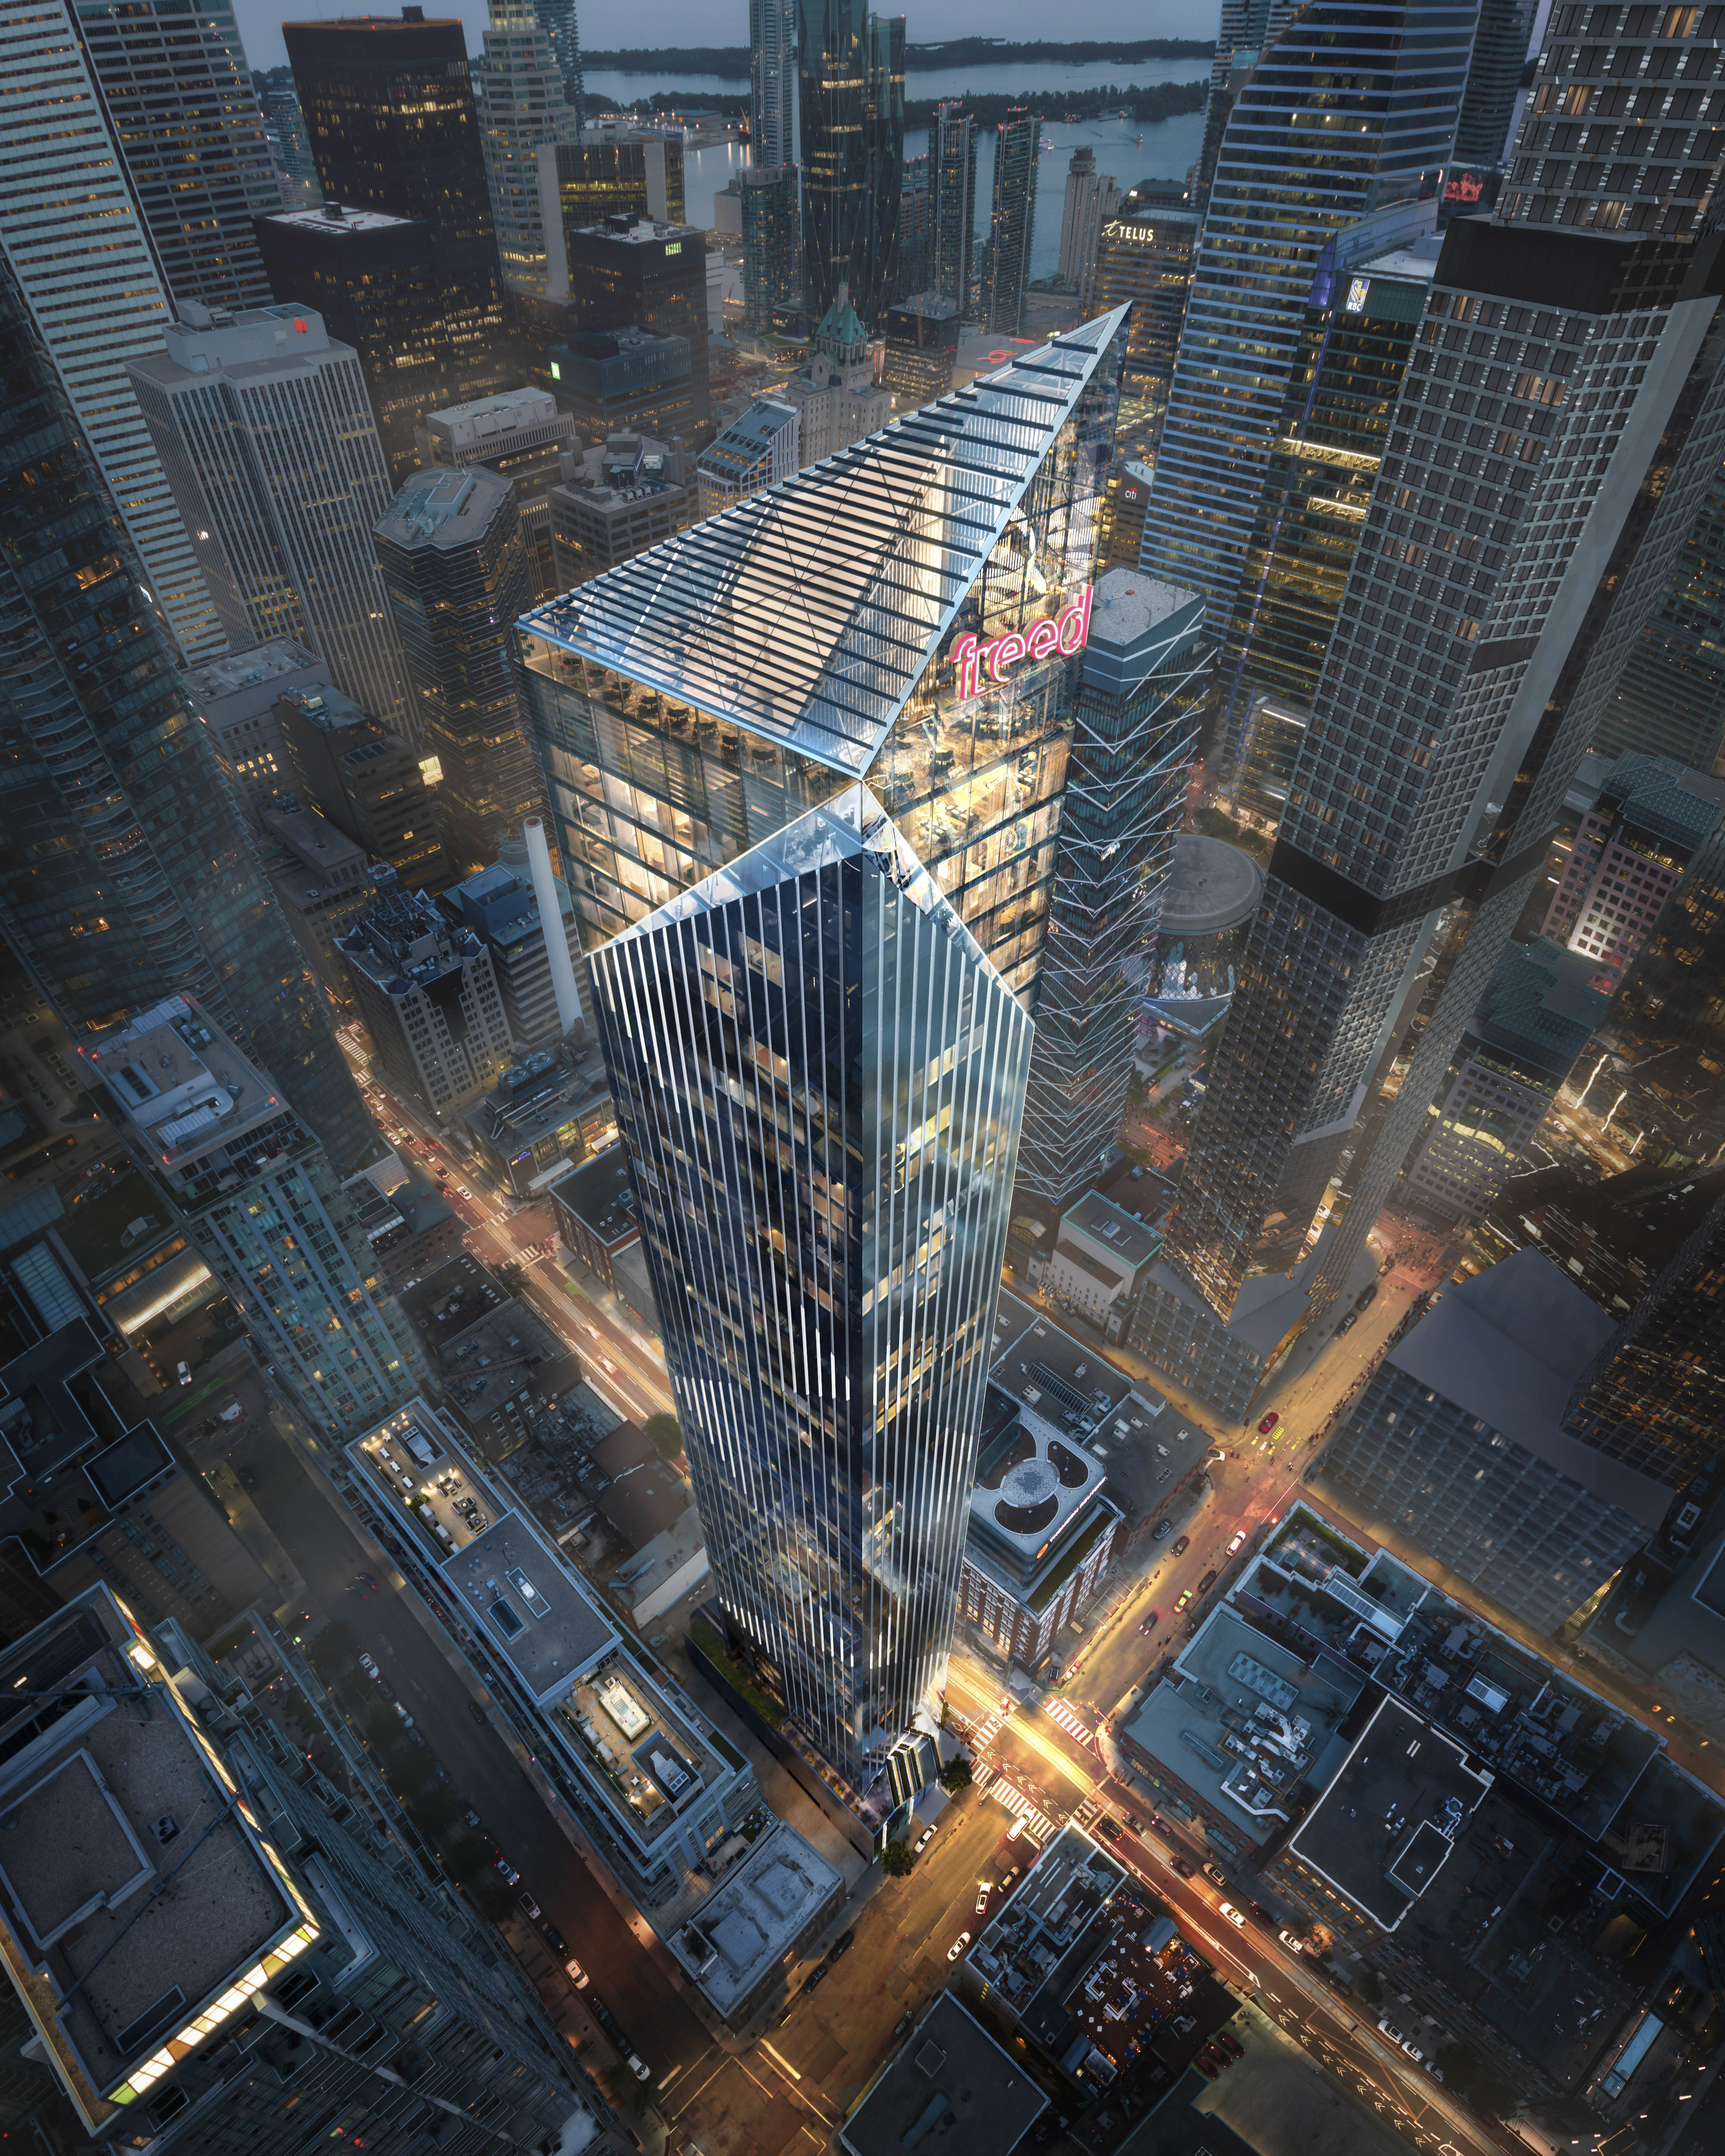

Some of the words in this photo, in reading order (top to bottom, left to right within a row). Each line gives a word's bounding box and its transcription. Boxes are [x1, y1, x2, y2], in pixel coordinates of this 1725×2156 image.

[1119, 225, 1154, 241] TELUS
[1347, 302, 1362, 312] RBC
[1125, 490, 1137, 500] citi
[949, 584, 1094, 700] freed
